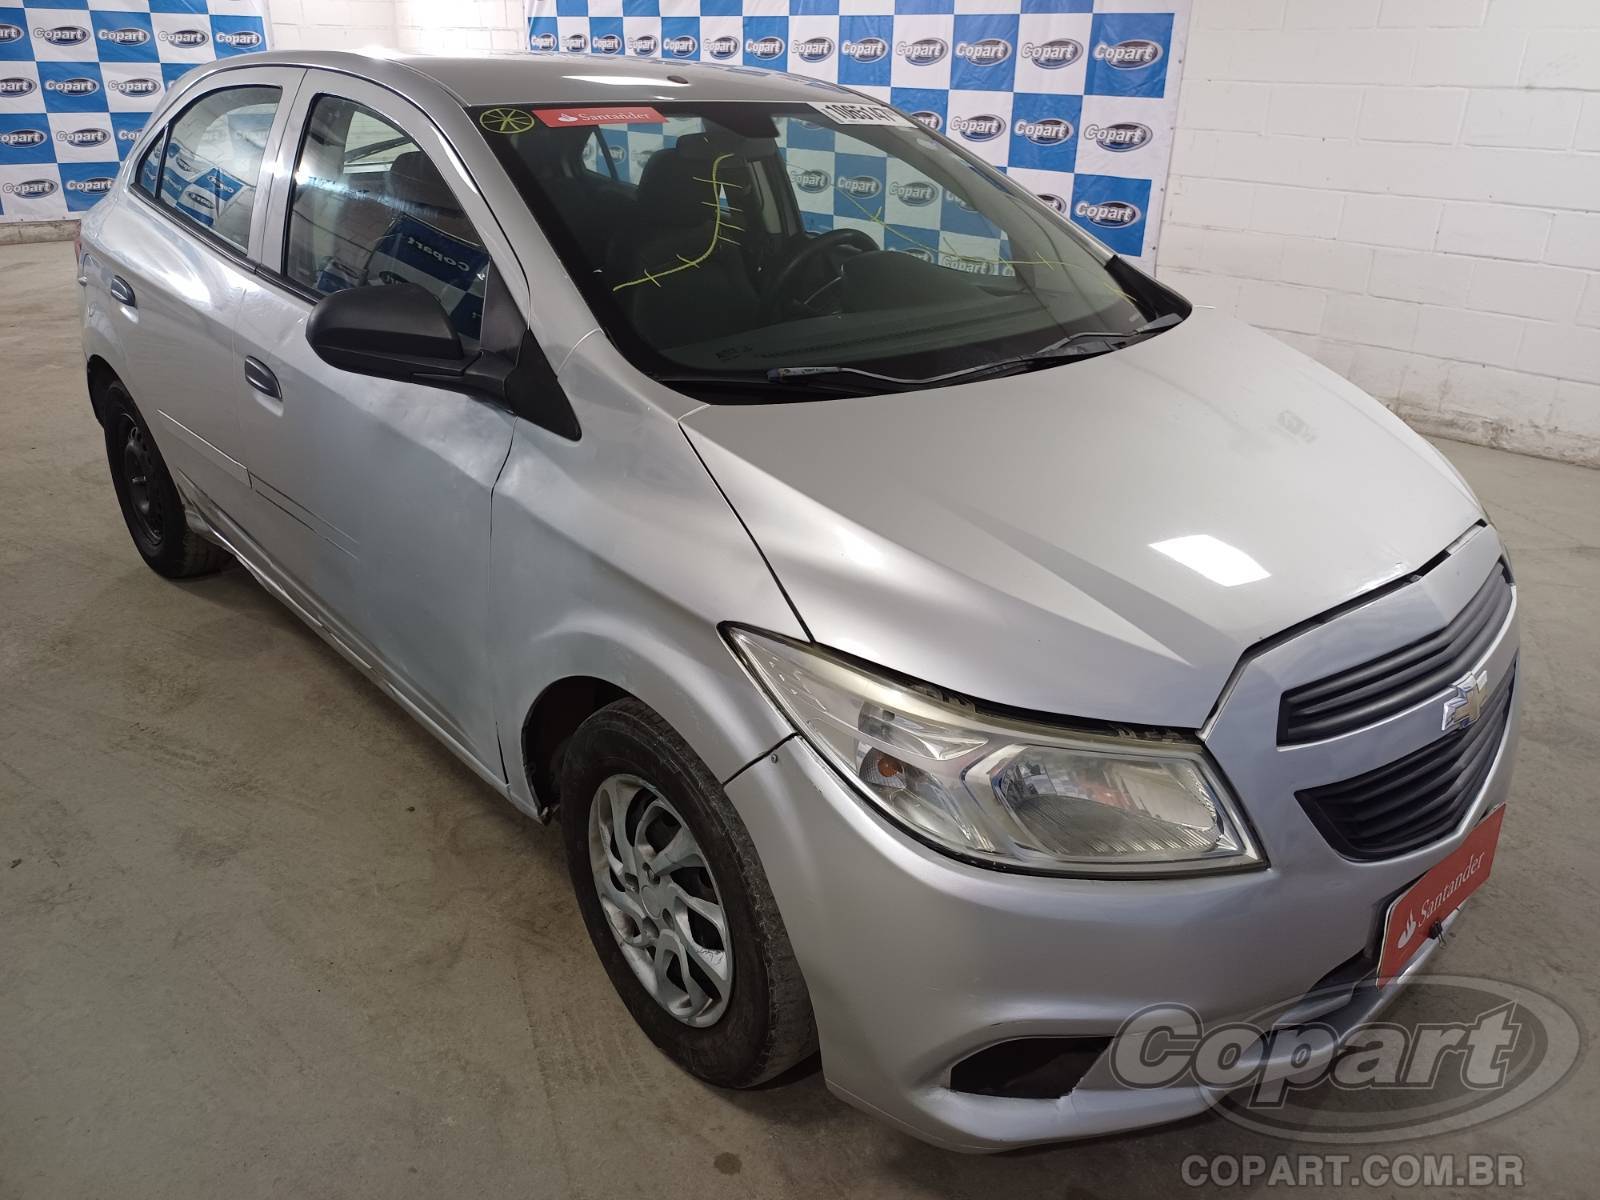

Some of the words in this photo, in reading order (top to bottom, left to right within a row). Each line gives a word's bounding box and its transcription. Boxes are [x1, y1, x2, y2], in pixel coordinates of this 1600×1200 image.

[0, 28, 16, 38] art
[34, 27, 84, 42] Copart
[98, 29, 147, 43] Copart
[159, 31, 204, 44] Copart
[216, 32, 258, 46] Copart
[531, 35, 554, 48] Copart
[592, 36, 618, 50] Copart
[627, 37, 655, 52] Copart
[663, 38, 693, 52] Copart
[703, 38, 736, 54] Copart
[746, 39, 781, 55] Copart
[792, 40, 829, 57] Copart
[842, 40, 883, 58] Copart
[896, 41, 942, 58] Copart
[956, 42, 1005, 60] Copart
[1022, 42, 1075, 61] Copart
[1094, 41, 1153, 62] Copart
[0, 80, 29, 93] part
[45, 80, 93, 93] Copart
[108, 80, 153, 93] Copart
[578, 112, 650, 121] Santander
[950, 116, 999, 134] Copart
[1014, 118, 1067, 137] Copart
[0, 133, 42, 146] opart
[56, 131, 104, 144] Copart
[1084, 124, 1142, 145] Copart
[66, 181, 112, 192] Copart
[791, 171, 826, 187] Copart
[838, 176, 877, 193] Copart
[3, 182, 50, 195] Copart
[889, 182, 933, 201] Copart
[1074, 202, 1133, 222] Copart
[1418, 851, 1485, 927] Santander
